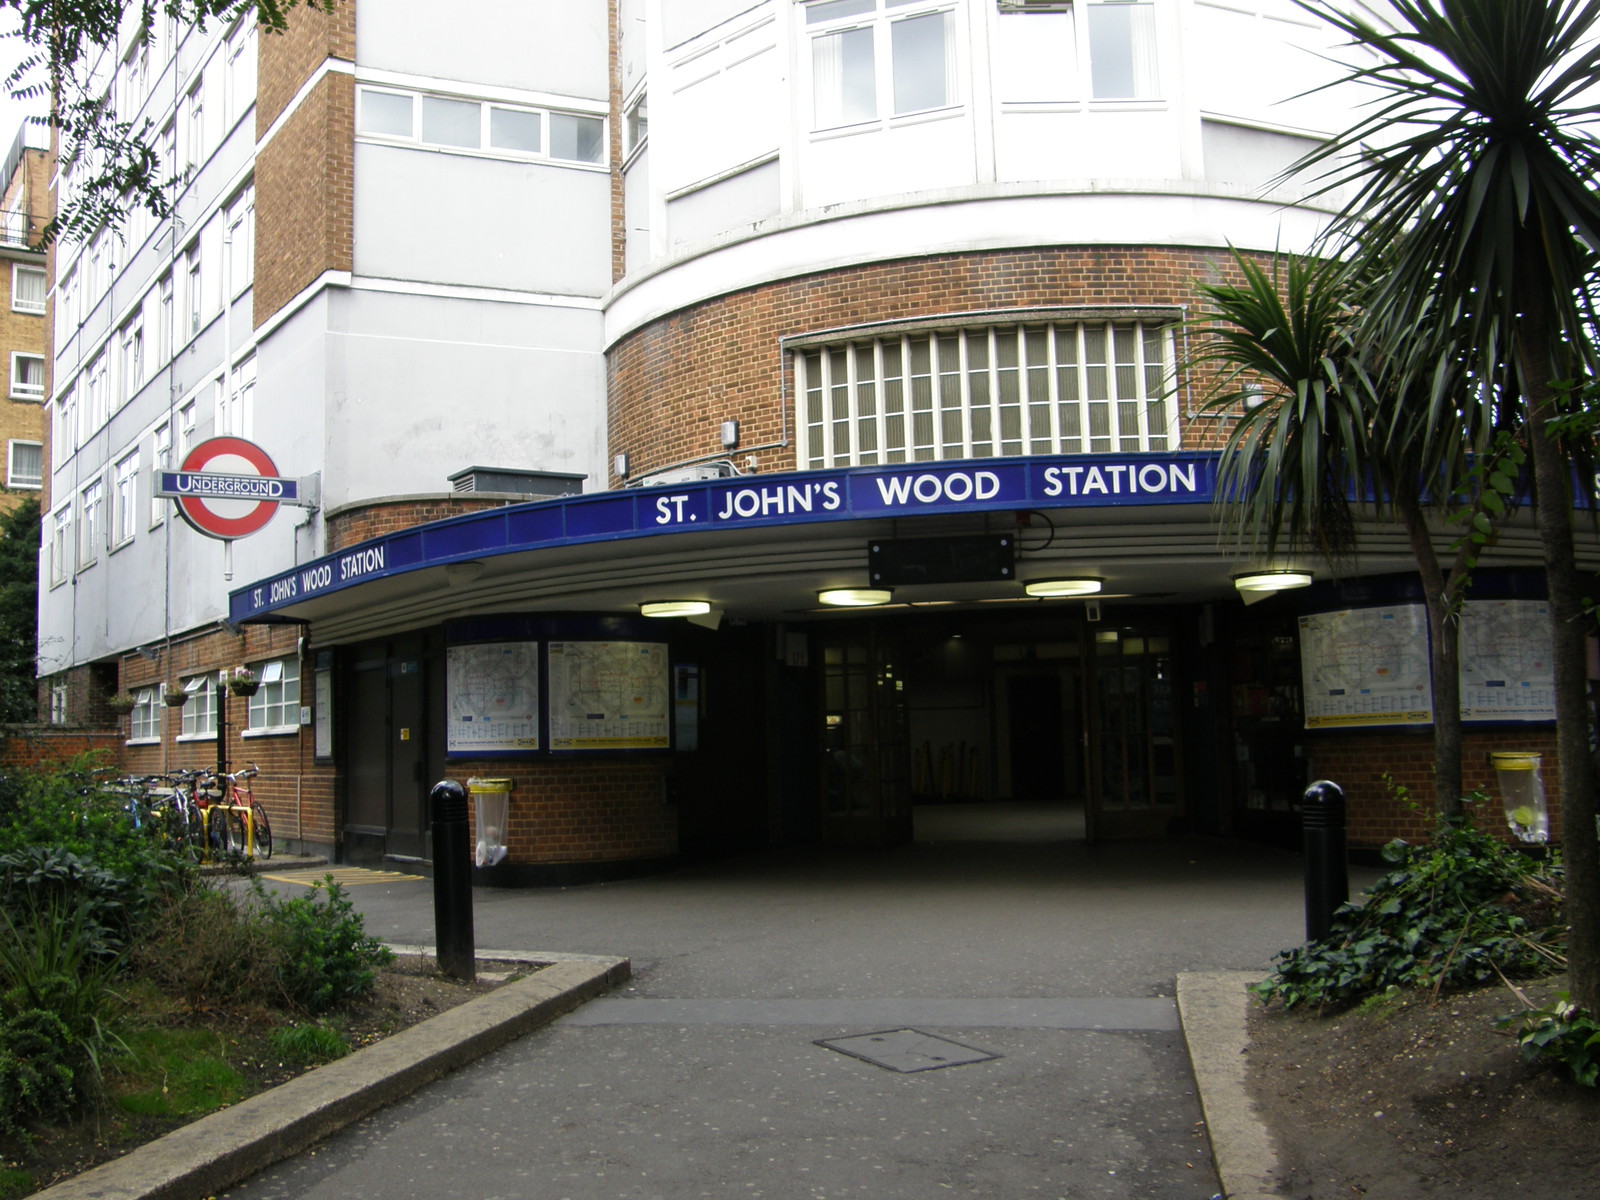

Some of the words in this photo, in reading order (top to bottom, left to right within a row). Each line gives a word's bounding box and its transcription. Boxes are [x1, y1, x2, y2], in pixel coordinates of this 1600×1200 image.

[176, 474, 283, 497] UNDERGROUND
[656, 495, 697, 525] ST.
[718, 481, 841, 520] JOHN'S
[876, 471, 1000, 505] WOOD
[1043, 463, 1196, 496] STATION
[253, 588, 264, 608] ST.
[269, 576, 296, 603] JOHN'S
[302, 565, 331, 592] WOOD
[341, 546, 383, 580] STATION
